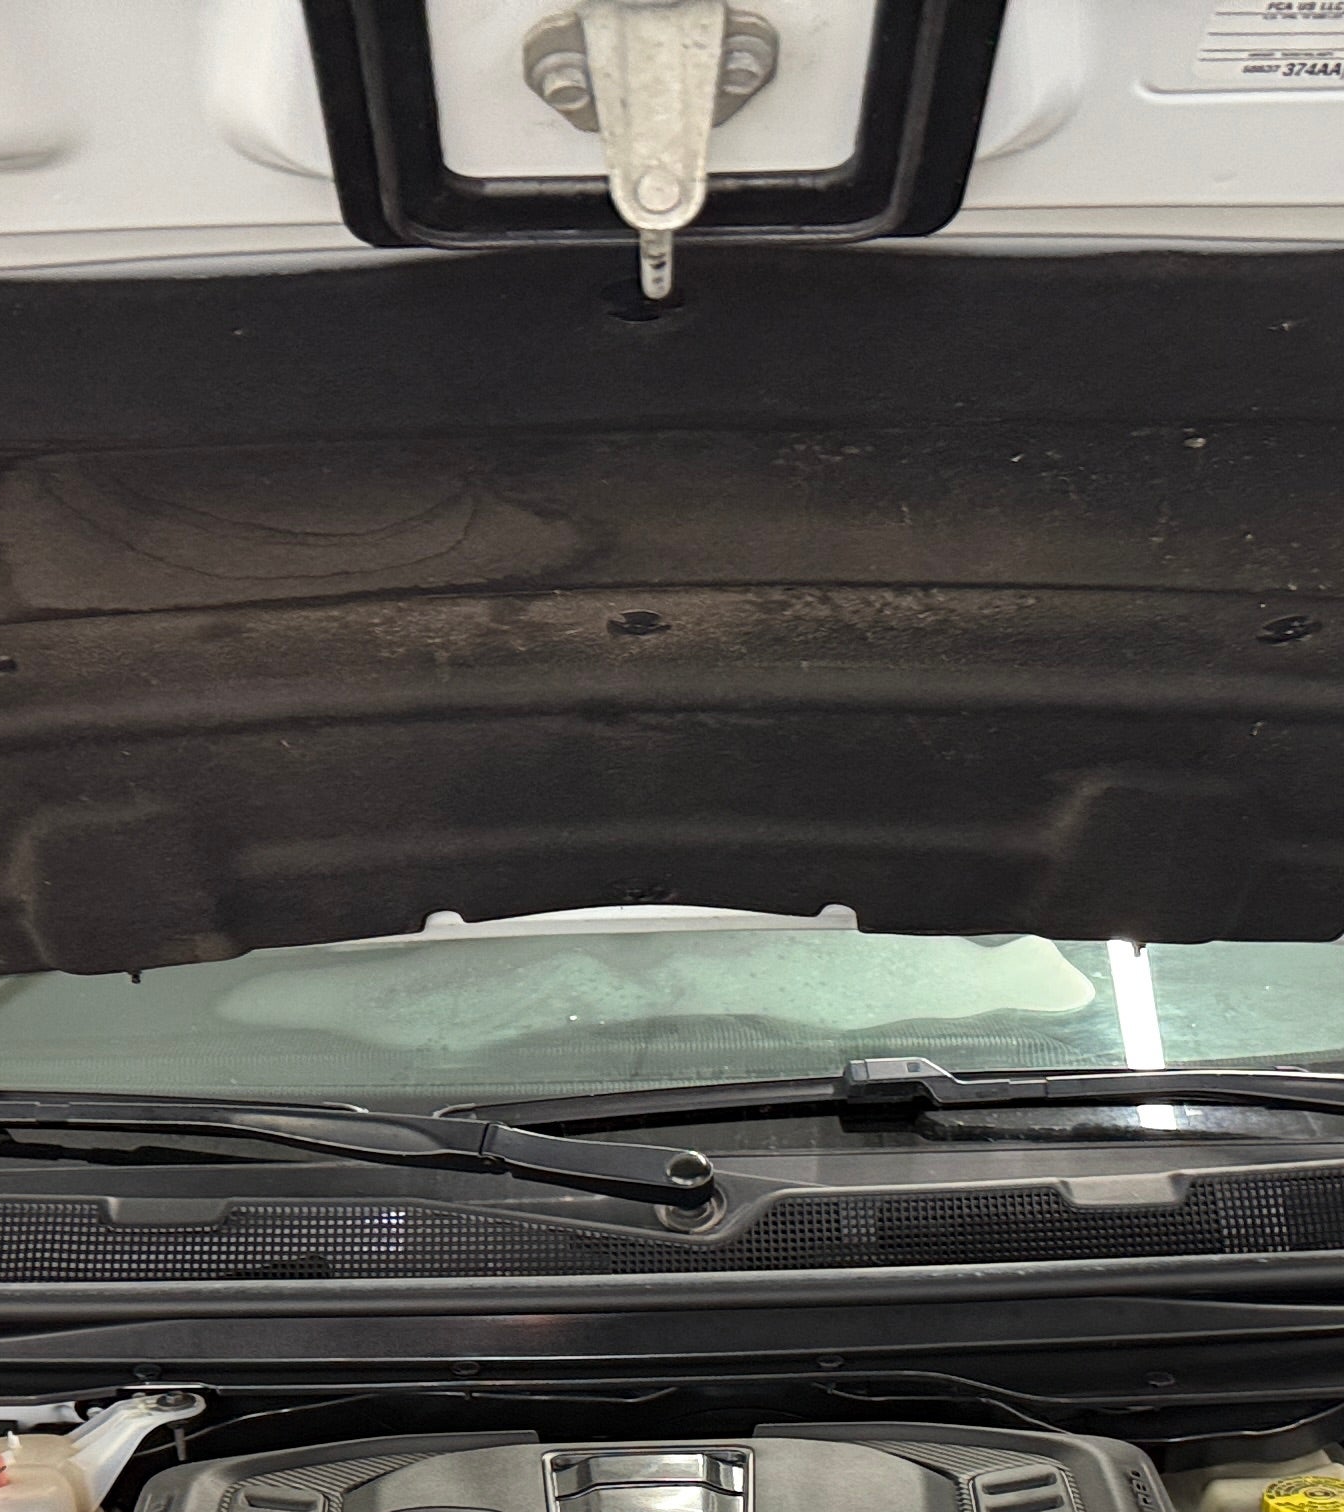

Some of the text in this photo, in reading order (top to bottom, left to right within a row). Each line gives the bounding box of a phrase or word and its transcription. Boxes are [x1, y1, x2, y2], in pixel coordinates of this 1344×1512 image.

[1267, 2, 1344, 10] FCA US LLC
[1282, 62, 1342, 77] 374AA
